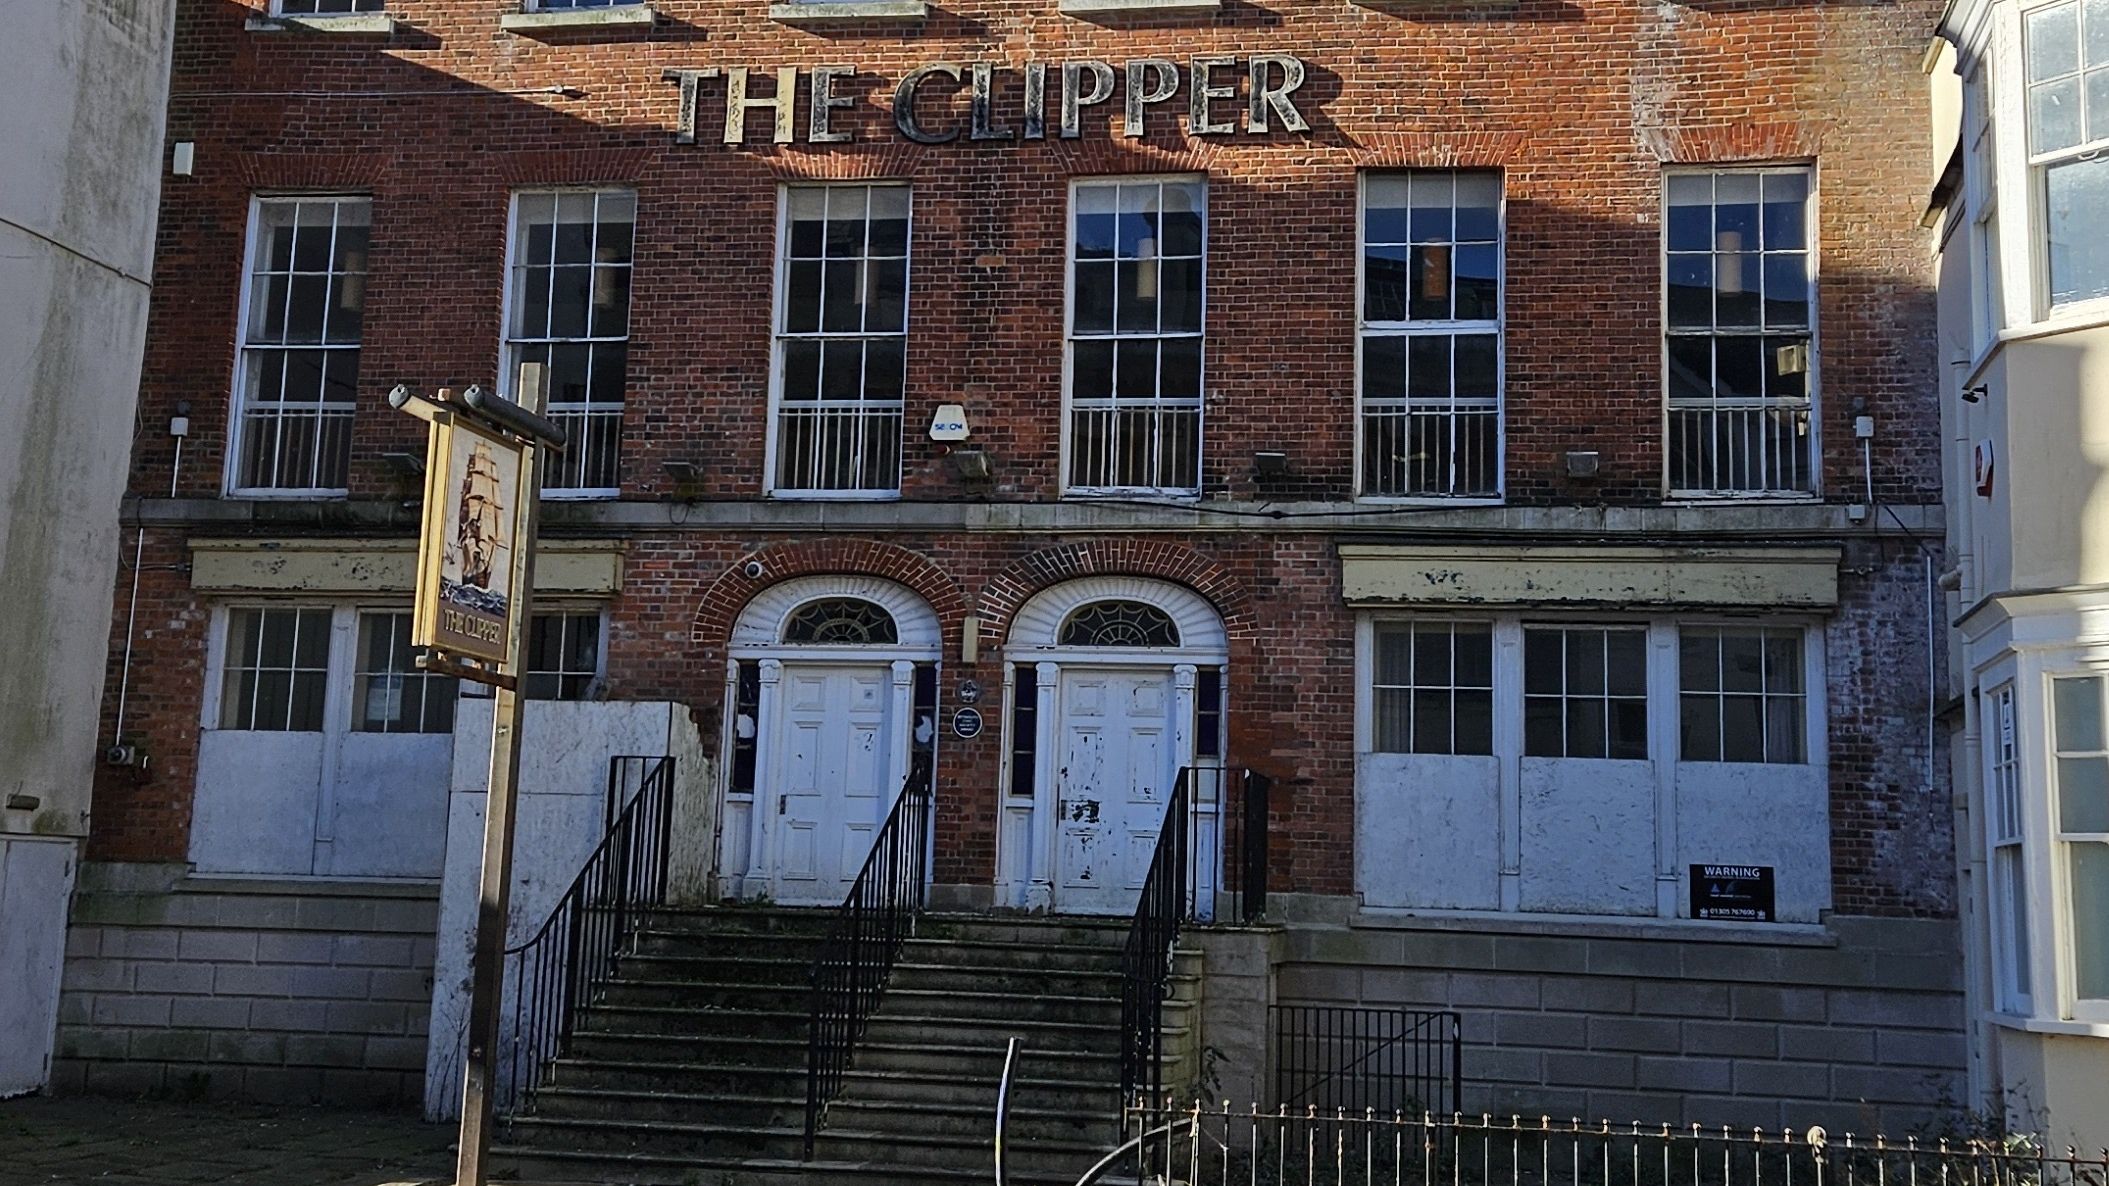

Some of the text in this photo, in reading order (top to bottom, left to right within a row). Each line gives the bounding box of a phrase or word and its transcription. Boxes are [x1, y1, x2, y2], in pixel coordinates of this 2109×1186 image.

[663, 54, 1311, 145] THE CLIPPER
[444, 608, 502, 645] THE CLIPPER
[1704, 866, 1760, 878] WARNING
